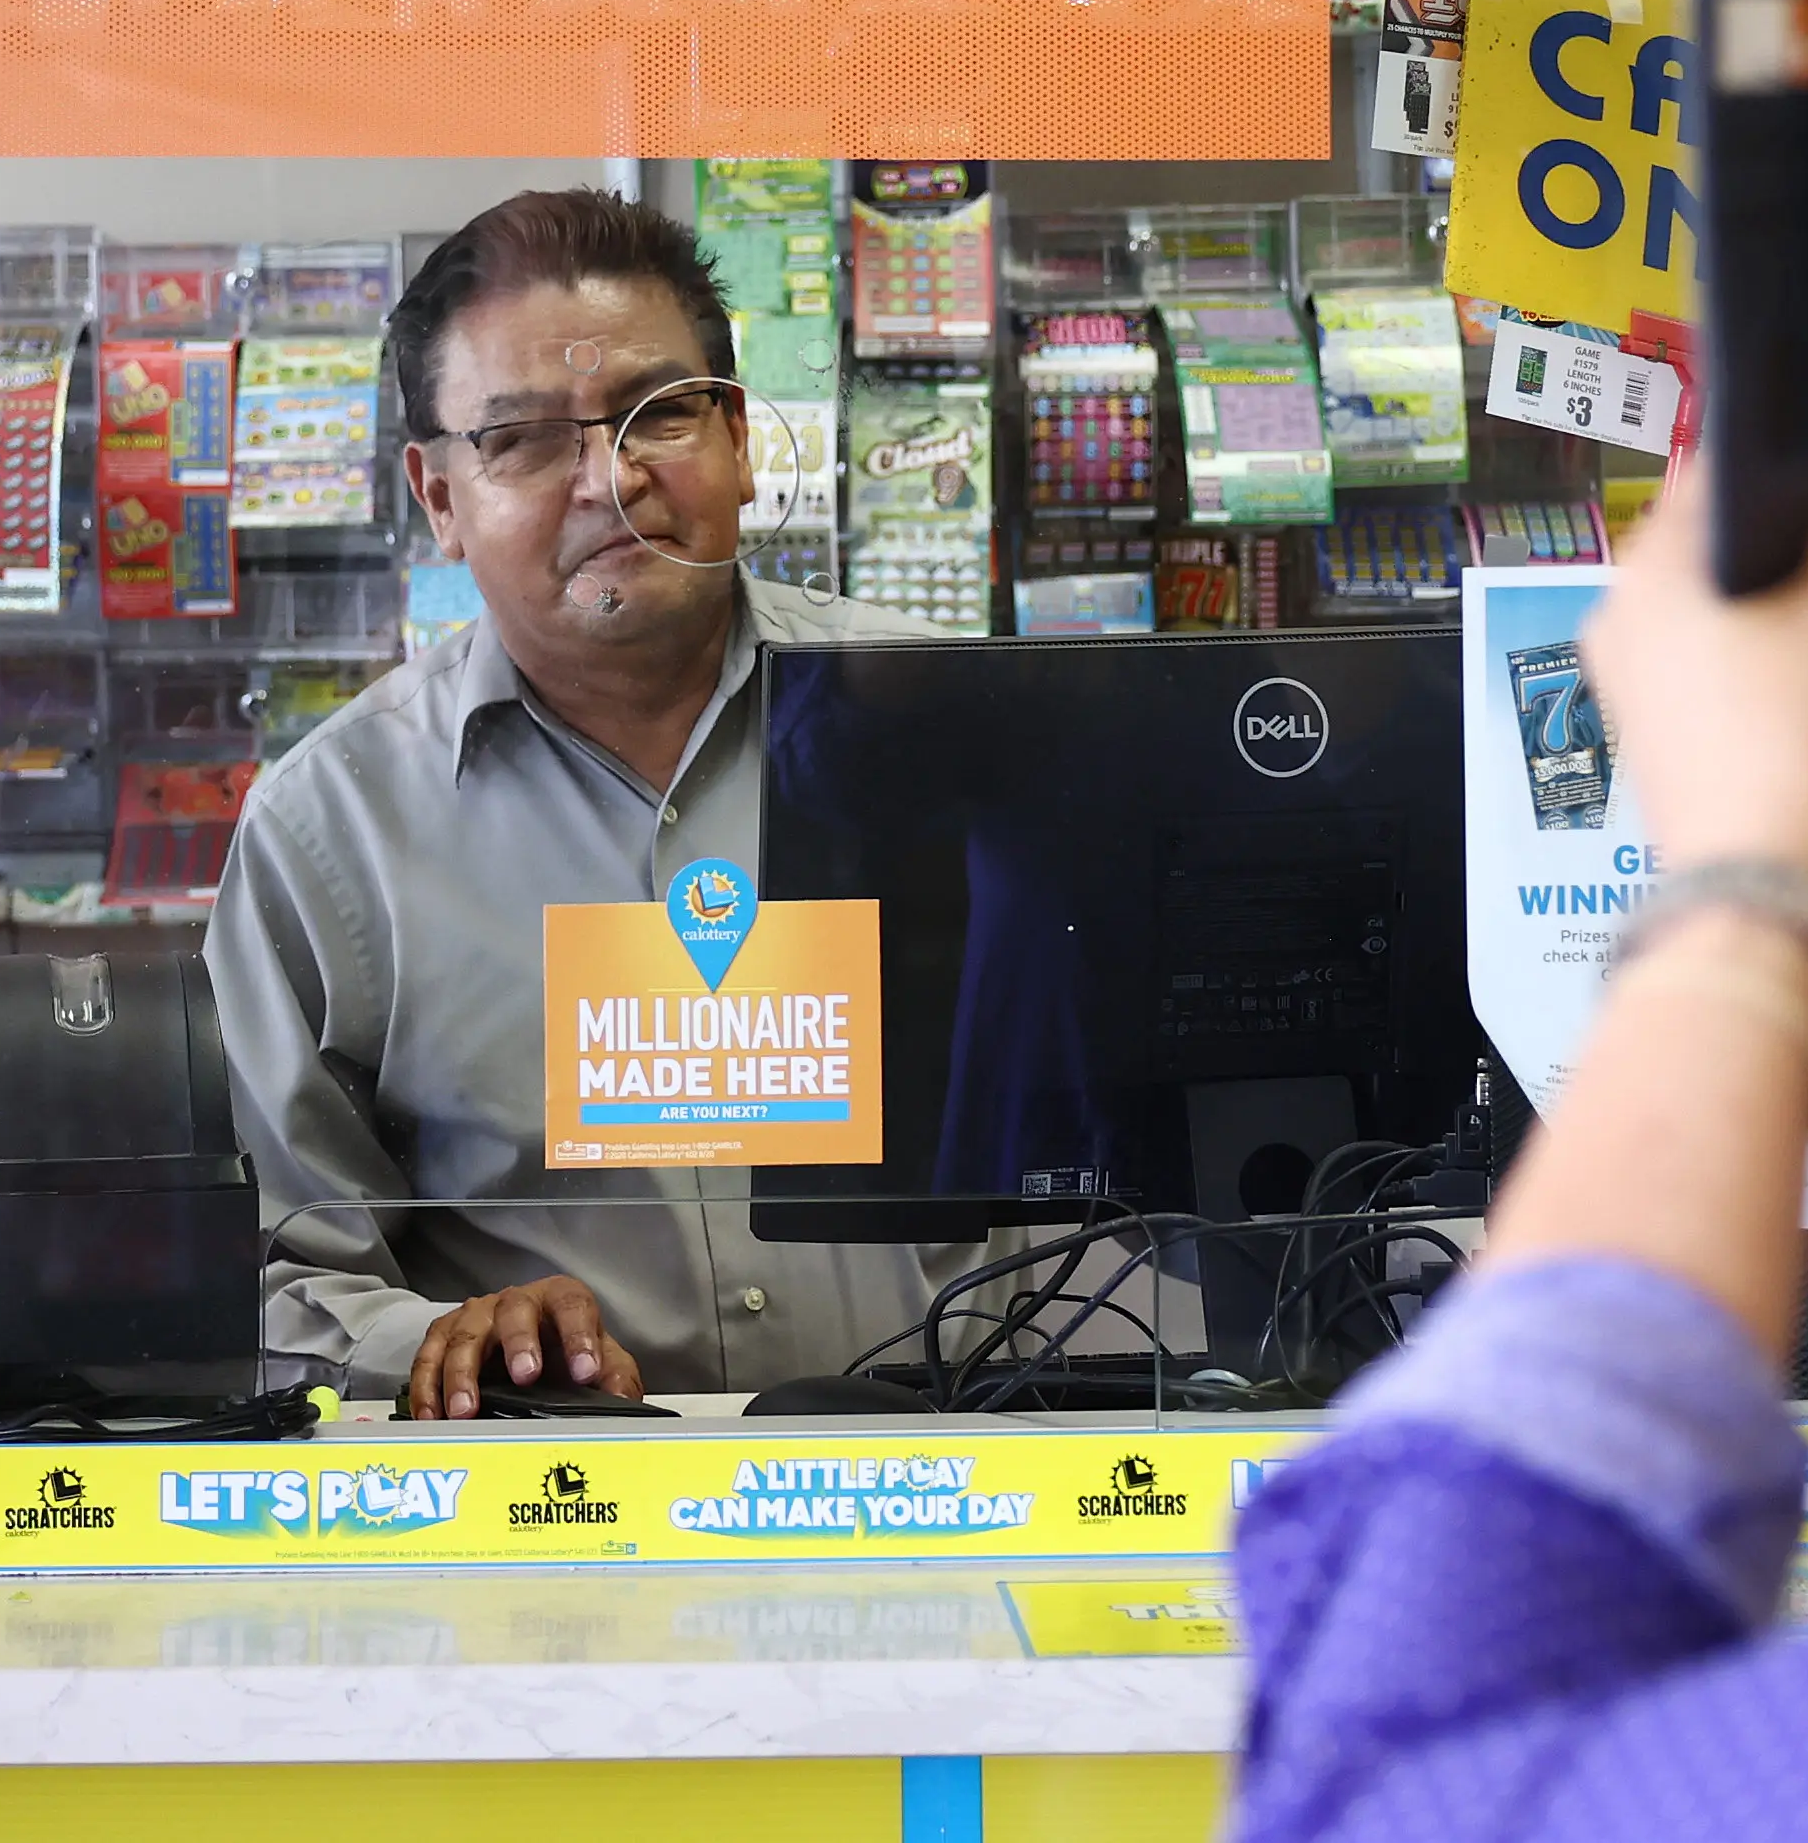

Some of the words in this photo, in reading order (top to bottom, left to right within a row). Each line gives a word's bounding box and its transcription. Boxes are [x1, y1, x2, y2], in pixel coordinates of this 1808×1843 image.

[1575, 345, 1601, 360] GAME
[1567, 368, 1602, 384] LENGTH
[1570, 381, 1602, 397] INCHES
[1566, 395, 1593, 427] $3
[1518, 657, 1578, 674] PREMIER
[1246, 714, 1318, 740] DELL
[682, 927, 741, 945] calottery
[1560, 929, 1611, 944] Prizes
[578, 994, 850, 1052] MILLIONAIRE
[579, 1057, 712, 1098] MADE
[727, 1055, 850, 1096] HERE
[660, 1106, 688, 1120] ARE
[691, 1105, 719, 1119] YOU
[722, 1105, 768, 1119] NEXT?
